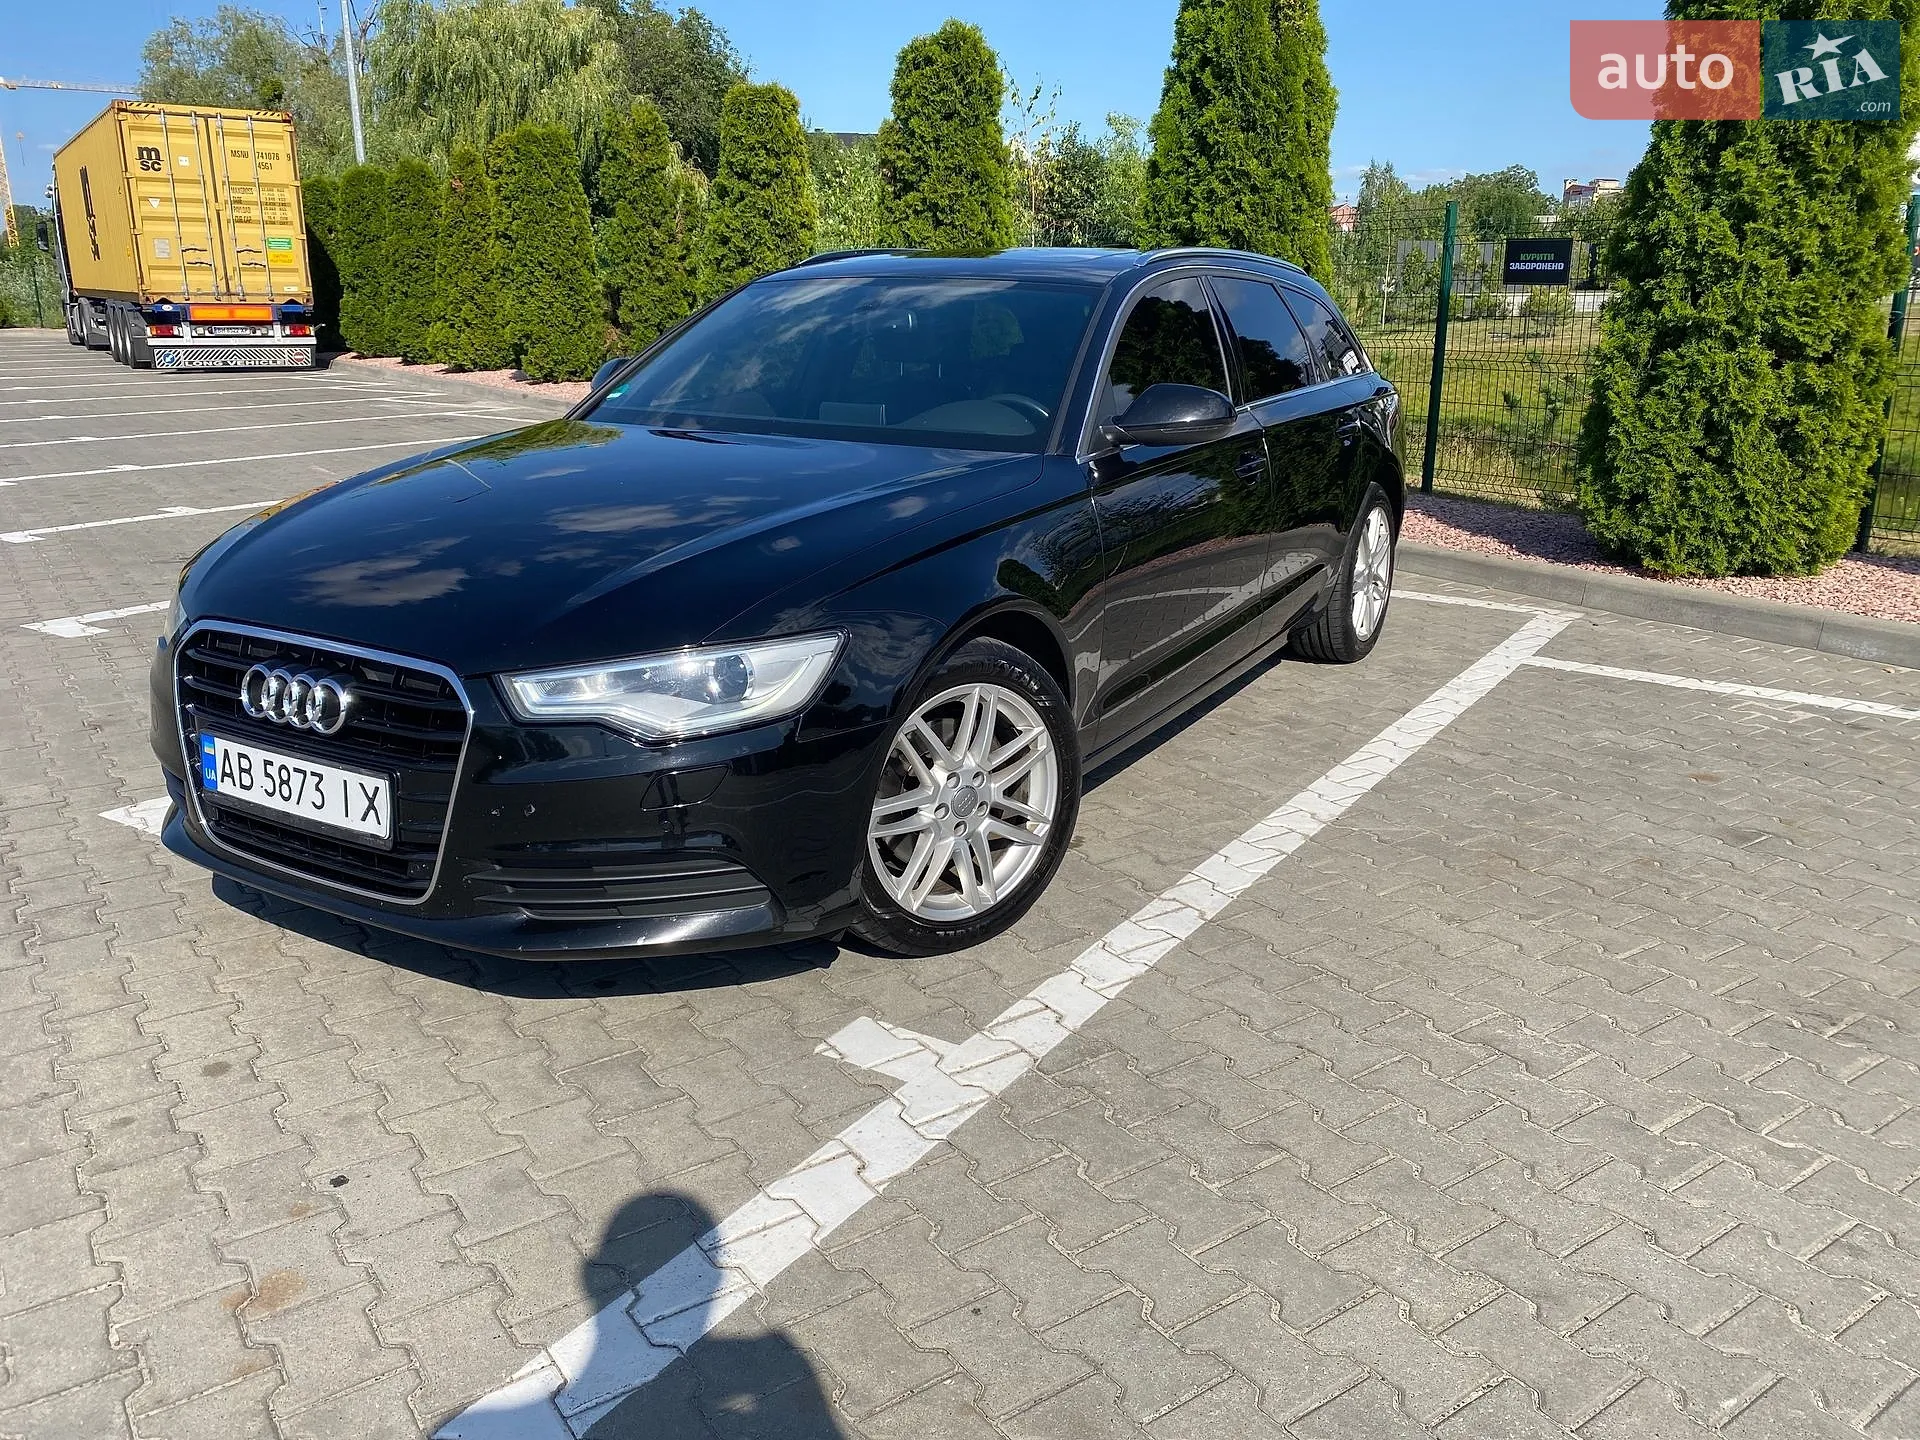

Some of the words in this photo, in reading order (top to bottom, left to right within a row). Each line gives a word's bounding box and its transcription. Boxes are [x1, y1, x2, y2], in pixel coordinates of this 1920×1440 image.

[230, 149, 249, 159] MSNU
[1520, 253, 1555, 261] КУРИТИ
[1509, 262, 1564, 270] ЗАБОРОНЕНО
[205, 767, 216, 781] UA
[220, 748, 254, 791] AB
[263, 758, 325, 810] 5873
[343, 779, 382, 826] IX
